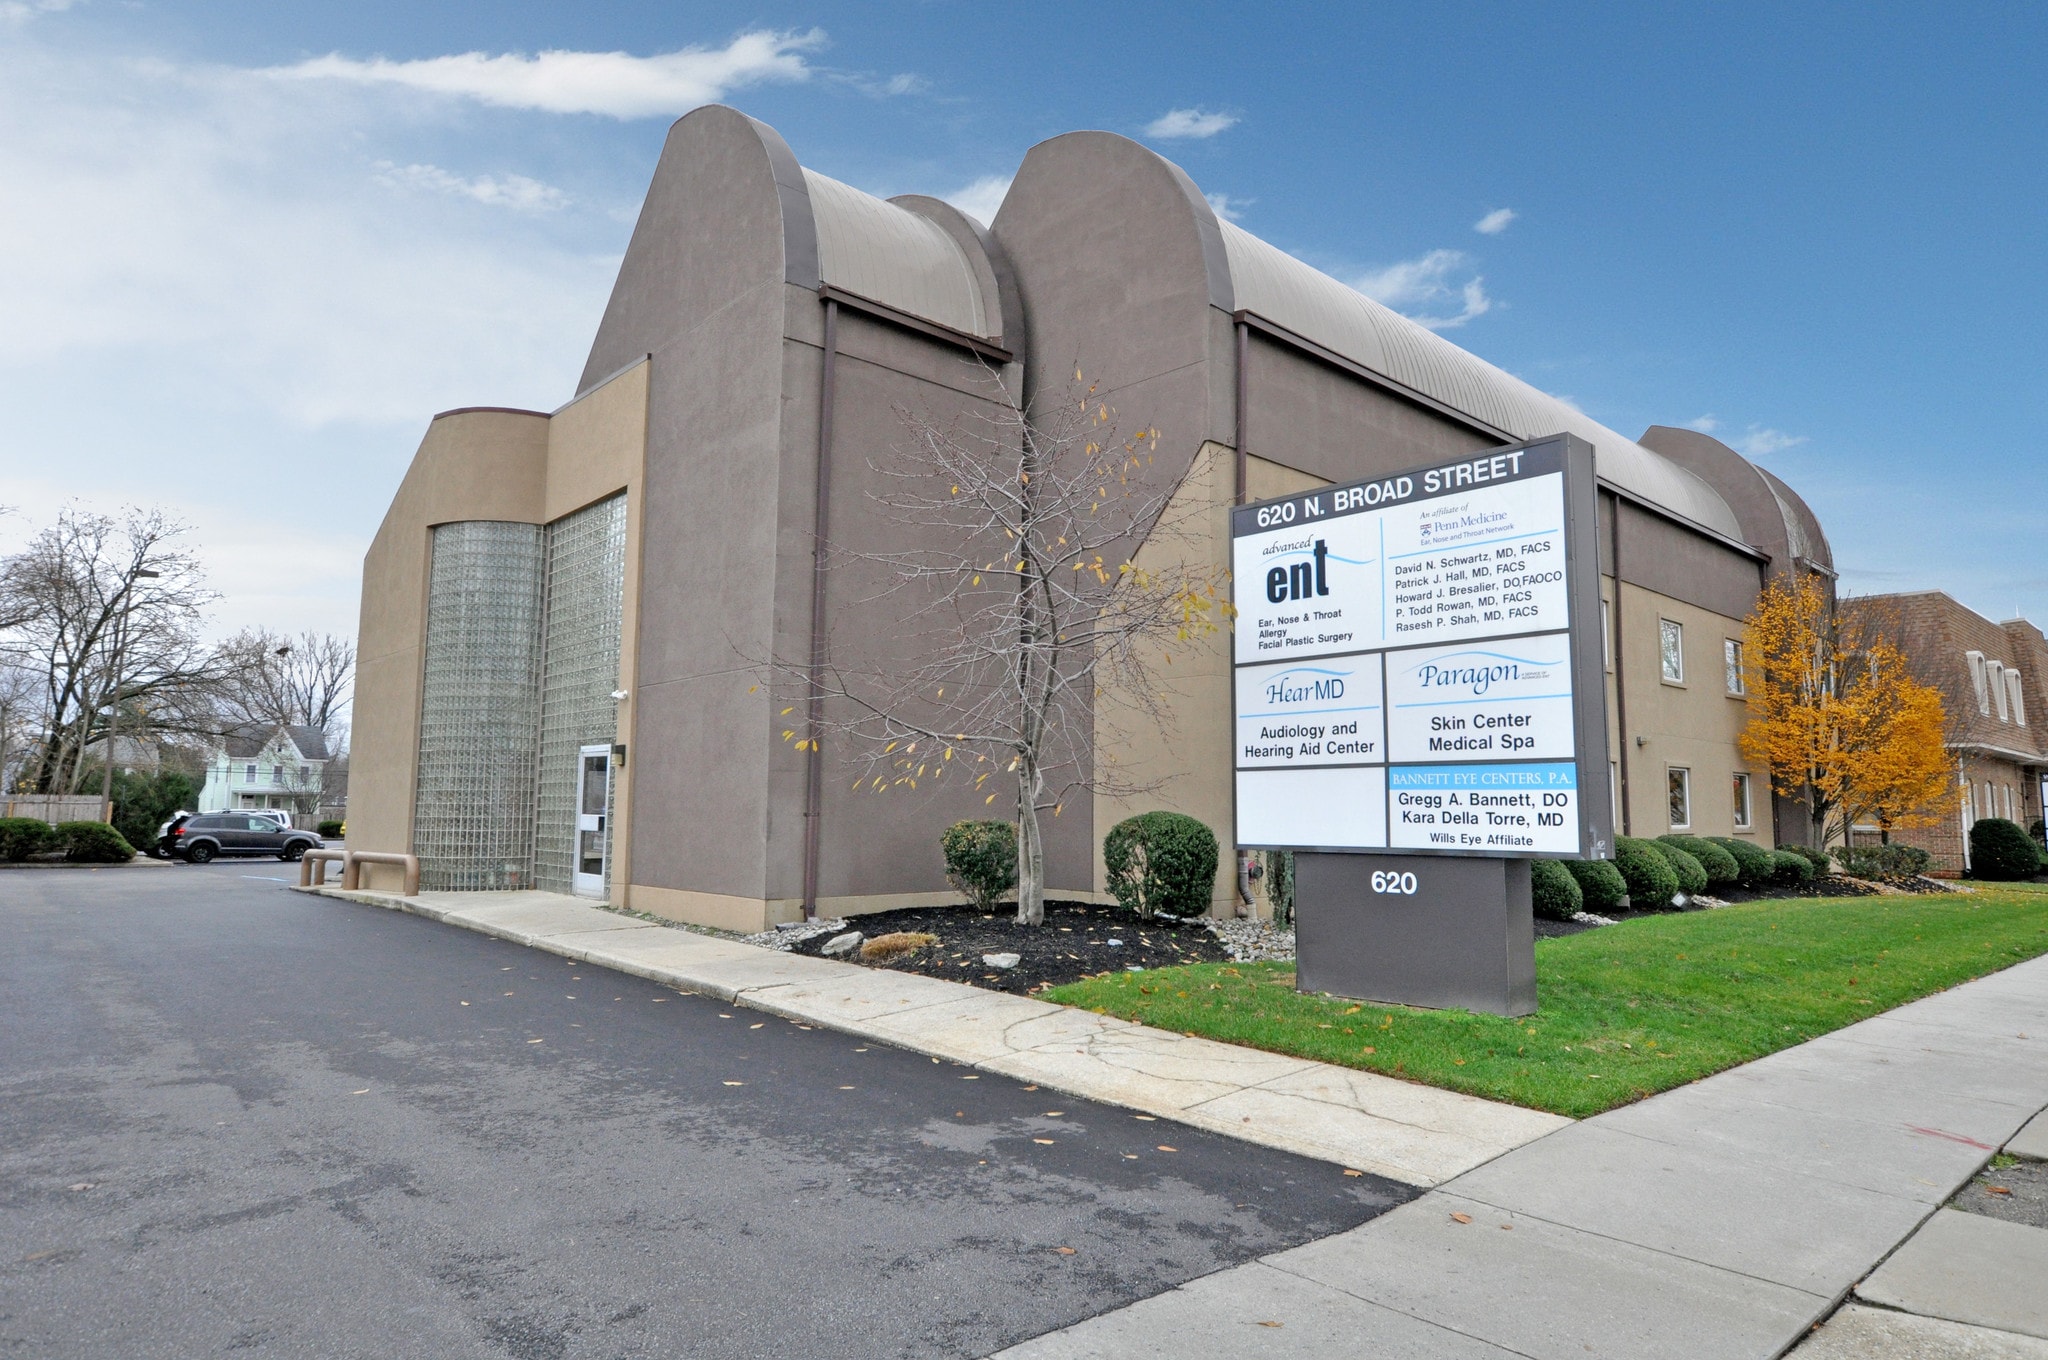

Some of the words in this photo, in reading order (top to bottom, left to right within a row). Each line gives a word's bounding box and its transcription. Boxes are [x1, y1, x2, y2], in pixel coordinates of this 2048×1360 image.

[1257, 502, 1296, 527] 620
[1304, 496, 1325, 518] N.
[1334, 477, 1413, 512] BROAD
[1424, 451, 1524, 493] STREET
[1420, 510, 1431, 520] An
[1431, 506, 1459, 518] affiliate
[1460, 502, 1469, 512] of
[1434, 521, 1459, 532] Penn
[1460, 511, 1508, 528] Medicine
[1433, 536, 1449, 544] Nose
[1450, 533, 1462, 541] and
[1464, 529, 1484, 538] Throat
[1485, 523, 1515, 534] Network
[1262, 534, 1314, 556] advanced
[1395, 562, 1422, 575] David
[1426, 560, 1436, 570] N.
[1440, 552, 1492, 569] Schwartz,
[1521, 541, 1551, 555] FACS
[1266, 539, 1329, 604] ent
[1395, 576, 1429, 589] Patrick
[1433, 575, 1441, 584] J.
[1446, 570, 1468, 582] Hall,
[1472, 567, 1492, 579] MD,
[1496, 560, 1526, 574] FACS
[1395, 590, 1433, 604] Howard
[1436, 589, 1445, 598] J.
[1449, 581, 1499, 597] Bresalier,
[1396, 609, 1405, 618] P.
[1409, 604, 1433, 616] Todd
[1436, 600, 1474, 613] Rowan,
[1503, 590, 1533, 604] FACS
[1258, 619, 1275, 628] Ear,
[1277, 615, 1300, 626] Nose
[1303, 613, 1310, 622] &
[1313, 609, 1342, 620] Throat
[1396, 619, 1433, 632] Rasesh
[1436, 618, 1446, 628] P.
[1450, 612, 1479, 626] Shah,
[1509, 605, 1538, 619] FACS
[1258, 640, 1283, 650] Facial
[1285, 635, 1314, 647] Plastic
[1317, 631, 1353, 643] Surgery
[1259, 628, 1288, 639] Allergy
[1419, 664, 1520, 695] Paragon
[1260, 724, 1326, 740] Audiology
[1332, 721, 1357, 735] and
[1431, 715, 1466, 731] Skin
[1473, 713, 1532, 729] Center
[1245, 744, 1294, 759] Hearing
[1299, 742, 1321, 756] Aid
[1327, 741, 1374, 754] Center
[1429, 735, 1492, 751] Medical
[1501, 733, 1535, 751] Spa
[1393, 773, 1450, 785] BANNETT
[1454, 773, 1477, 785] EYE
[1549, 772, 1572, 785] P.A.
[1398, 792, 1442, 808] Gregg
[1449, 793, 1463, 806] A.
[1469, 793, 1536, 809] Bannett,
[1543, 793, 1568, 807] DO
[1403, 810, 1435, 824] Kara
[1442, 811, 1479, 825] Della
[1485, 812, 1530, 828] Torre,
[1537, 812, 1564, 826] MD
[1430, 832, 1456, 843] Wills
[1460, 833, 1482, 846] Eye
[1487, 834, 1533, 846] Affiliate
[1371, 870, 1418, 895] 620
